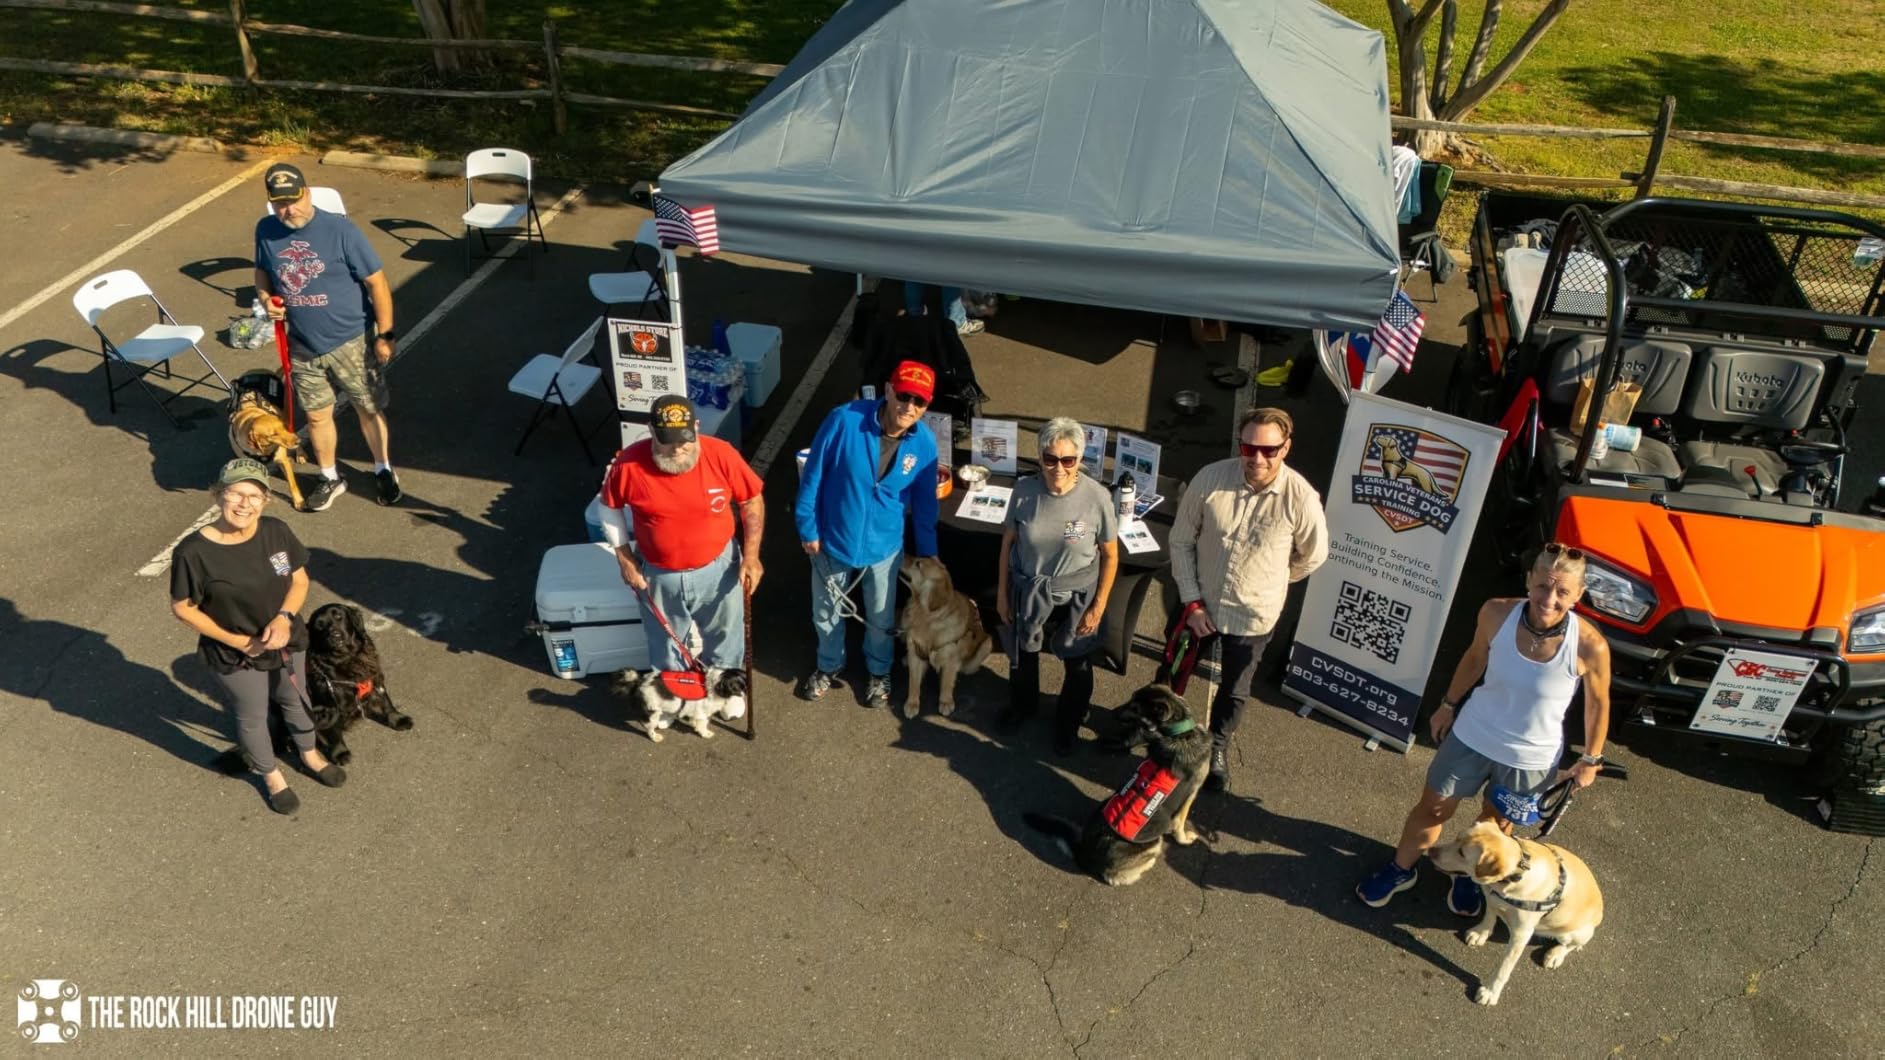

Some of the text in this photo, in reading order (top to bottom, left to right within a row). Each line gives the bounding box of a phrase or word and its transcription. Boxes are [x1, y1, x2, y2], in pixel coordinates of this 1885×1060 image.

[1362, 476, 1404, 489] CAROLINA
[1354, 483, 1452, 523] SERVICE DOG
[1382, 500, 1421, 518] TRAINING
[1384, 509, 1414, 524] CVSDT
[1331, 541, 1374, 563] Building
[1344, 532, 1433, 573] Training Service.
[1327, 552, 1445, 602] ontinuing the Mission.
[1292, 665, 1409, 727] 803-627-8234
[1311, 656, 1398, 706] CVSDT.org
[1716, 681, 1745, 690] PROUD
[1746, 685, 1783, 695] PARTNER
